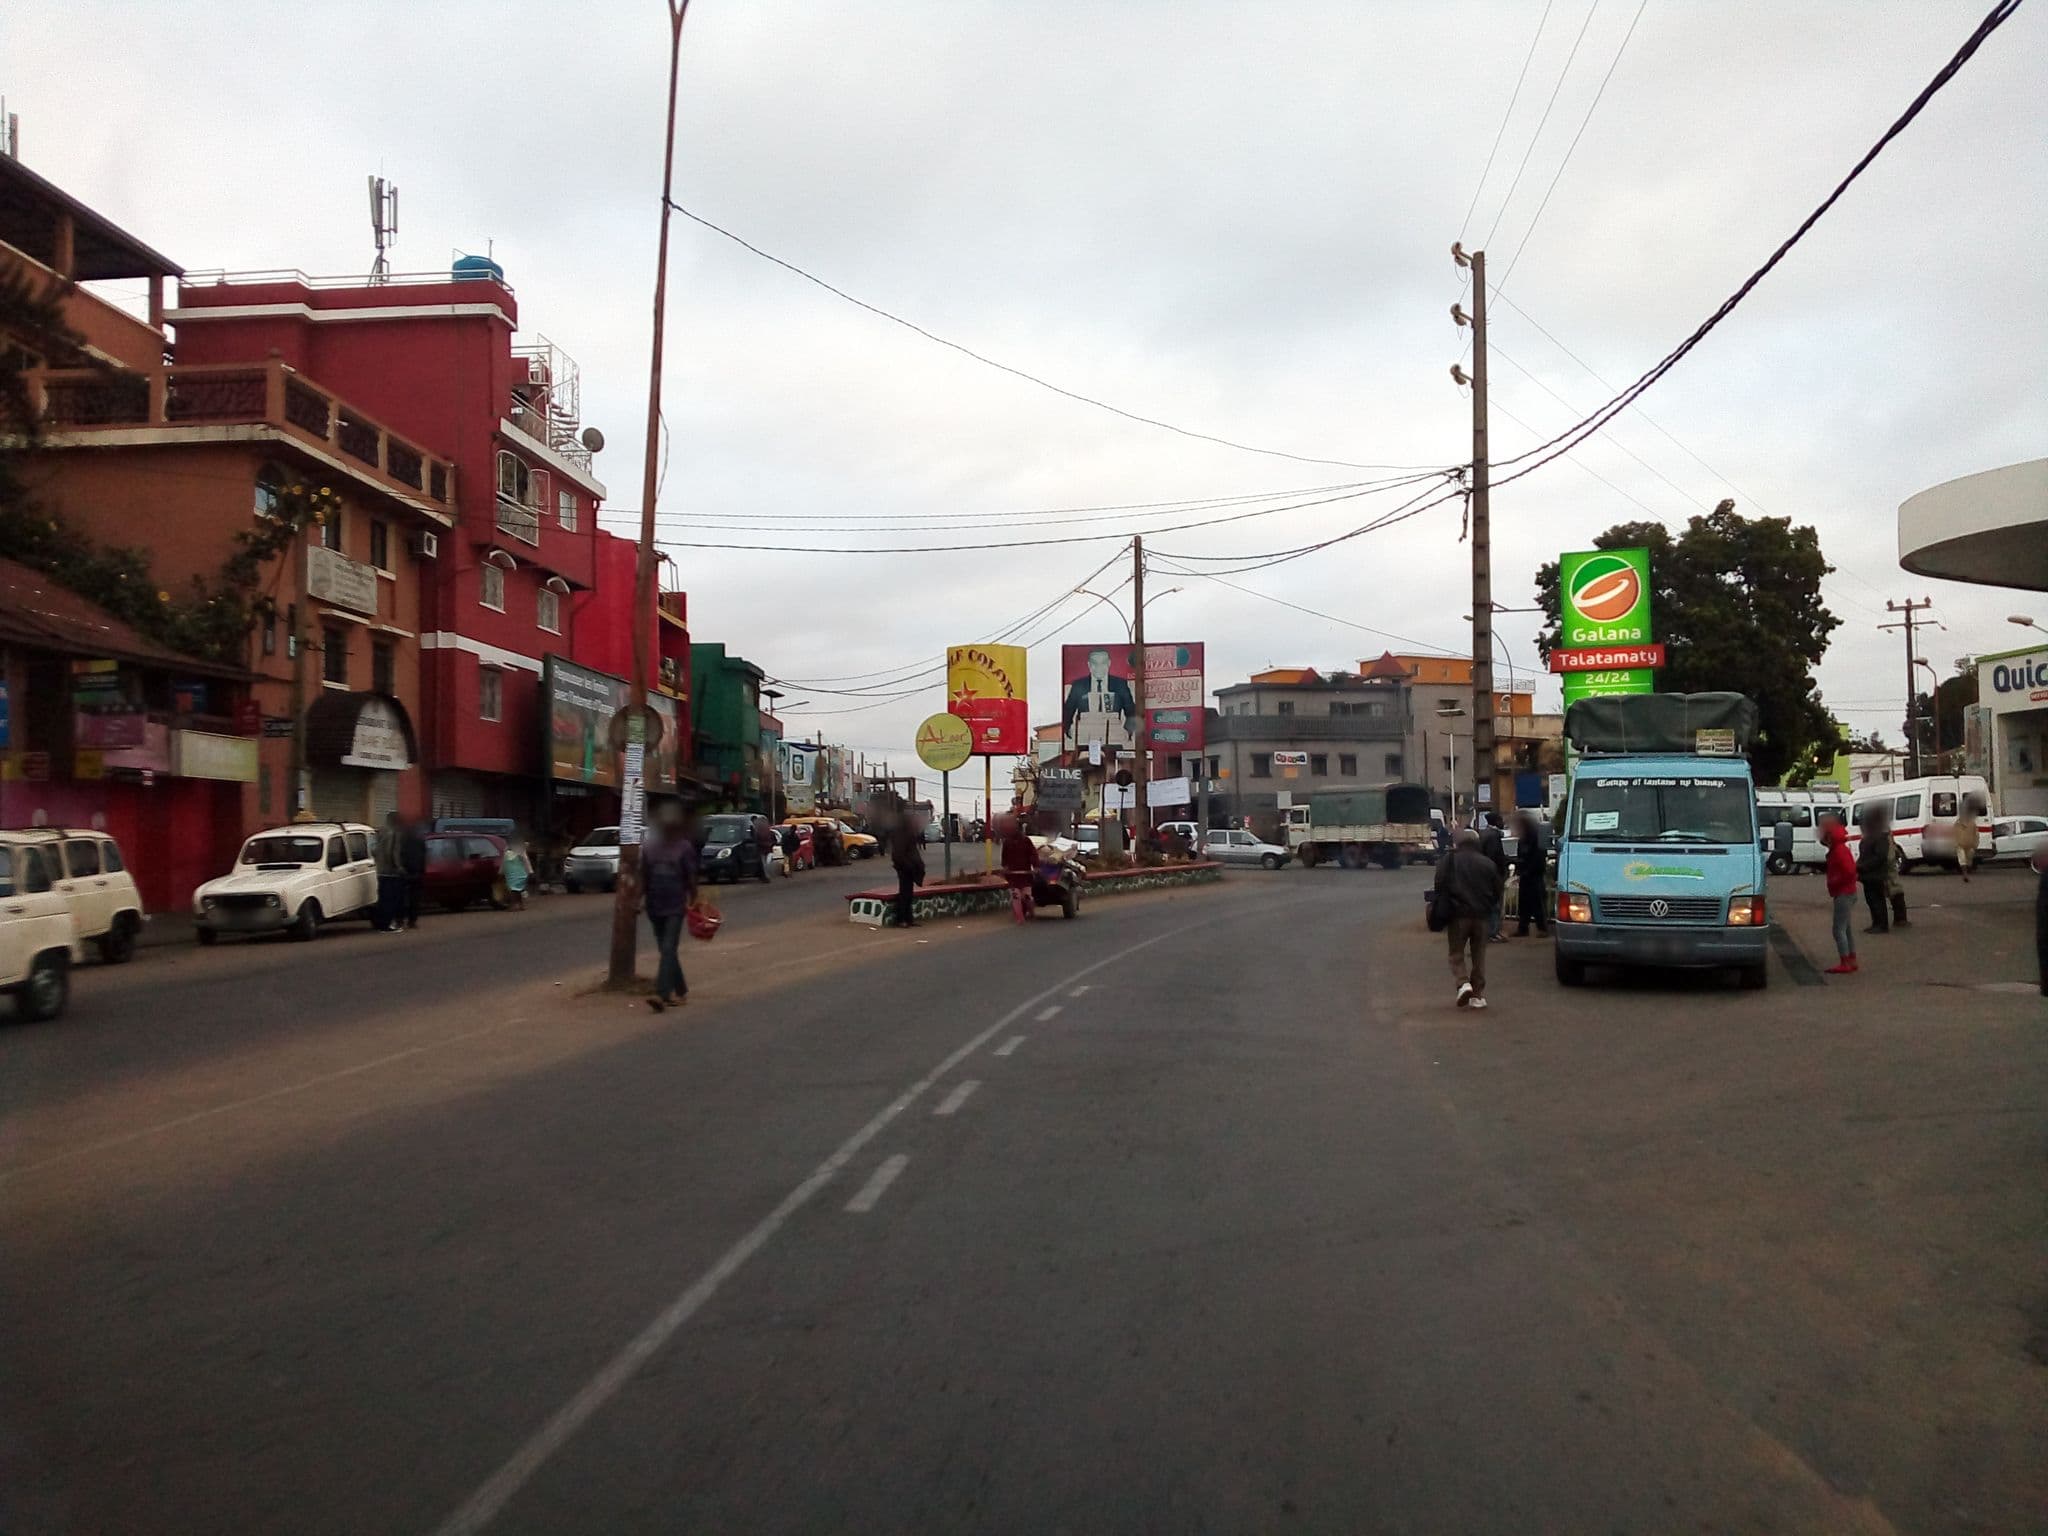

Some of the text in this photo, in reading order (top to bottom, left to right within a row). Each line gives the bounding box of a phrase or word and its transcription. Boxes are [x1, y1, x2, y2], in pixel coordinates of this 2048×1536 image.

[1572, 627, 1642, 642] Galana
[1559, 650, 1658, 665] Talatamaty
[1585, 671, 1630, 685] 24/24
